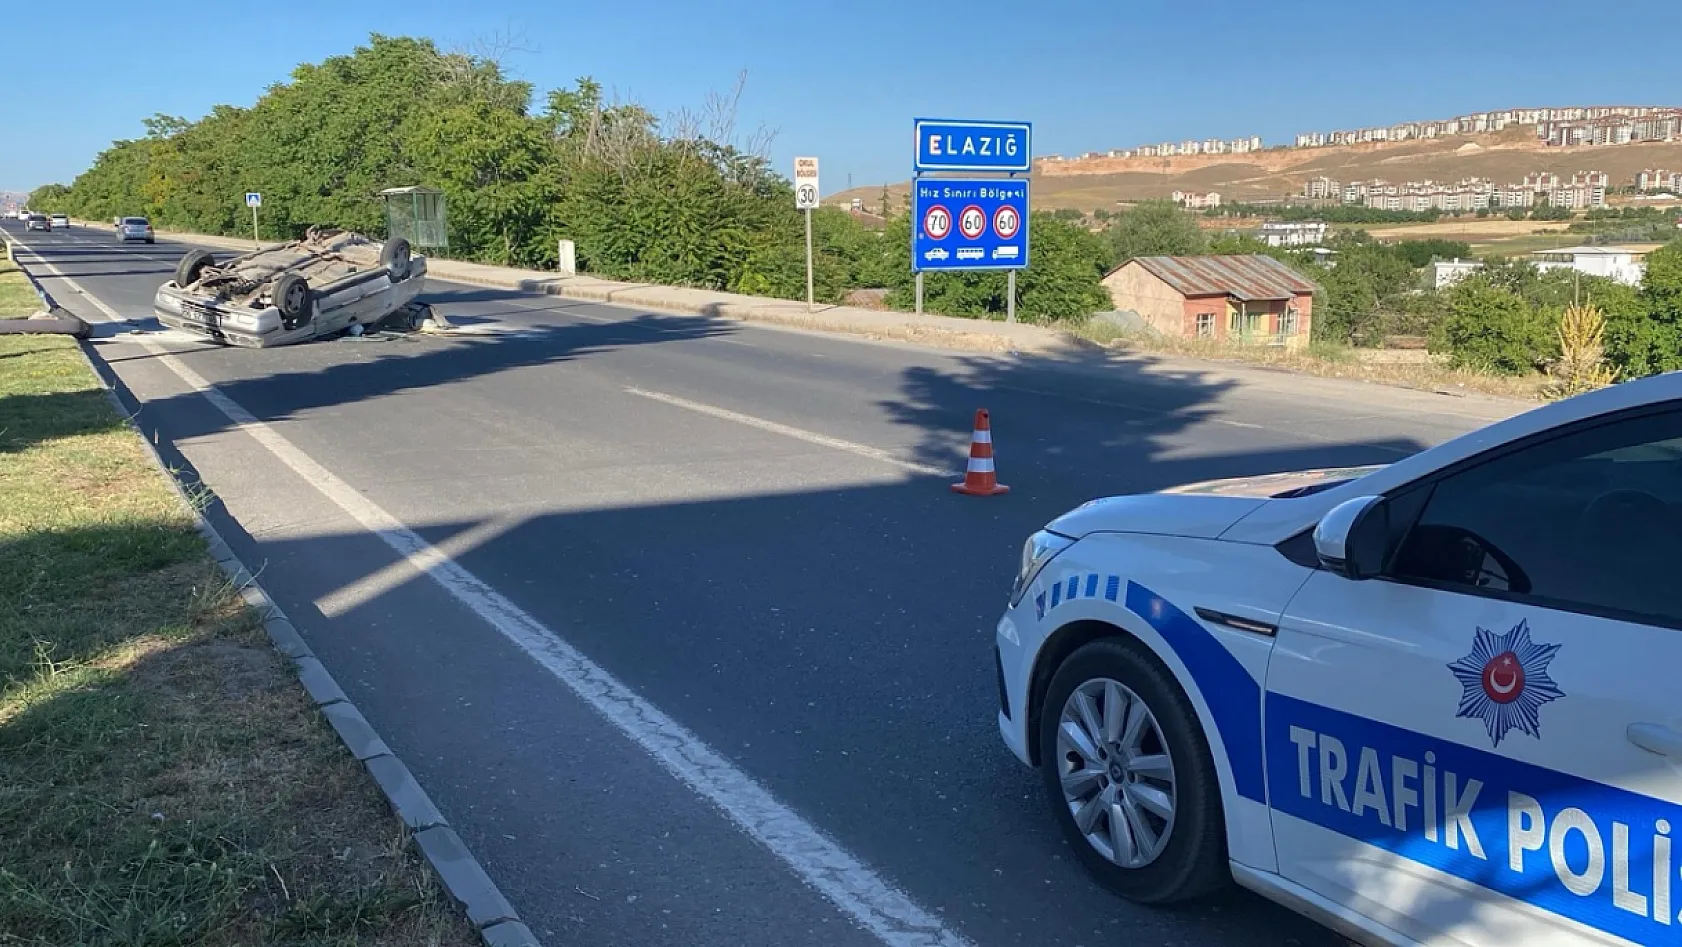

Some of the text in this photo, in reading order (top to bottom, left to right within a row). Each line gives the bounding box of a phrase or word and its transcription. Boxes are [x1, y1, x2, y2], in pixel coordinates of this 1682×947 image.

[929, 134, 1018, 157] ELAZIĞ
[800, 188, 815, 204] 30
[920, 188, 940, 199] Hız
[980, 187, 1025, 201] Bölgesi
[930, 214, 1015, 230] 70 60 60
[1289, 724, 1682, 926] TRAFİK POLİ
